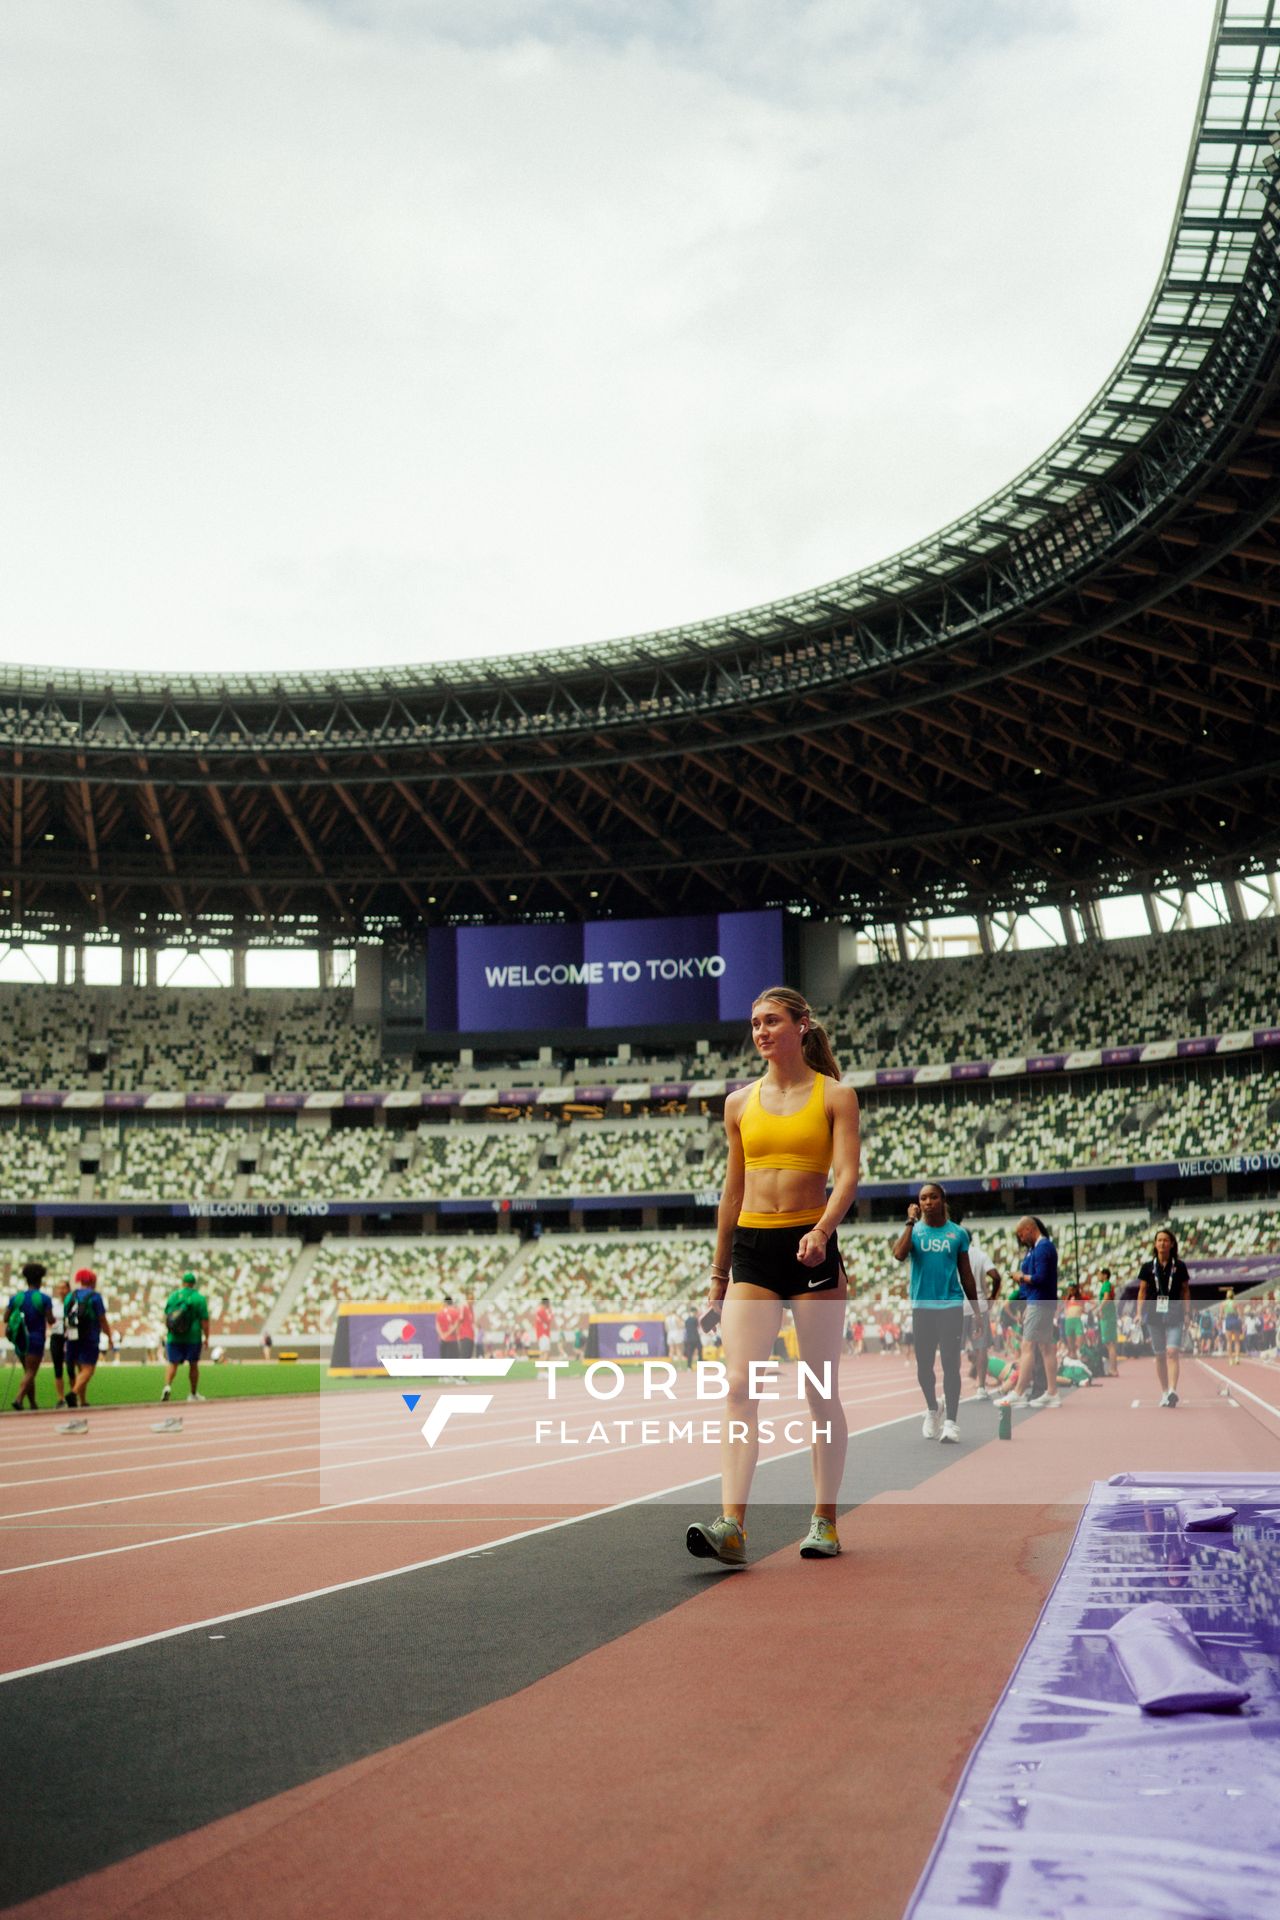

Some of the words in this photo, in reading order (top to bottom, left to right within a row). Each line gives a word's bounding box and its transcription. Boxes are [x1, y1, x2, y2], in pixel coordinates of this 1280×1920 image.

[485, 963, 604, 988] WELCOME
[608, 961, 641, 982] TO
[646, 956, 726, 980] TOKYO
[1178, 1158, 1241, 1177] WELCOME
[1244, 1155, 1261, 1171] TO
[188, 1202, 258, 1216] WELCOME
[263, 1202, 280, 1216] TO
[285, 1201, 329, 1216] TOKYO
[921, 1239, 951, 1253] USA
